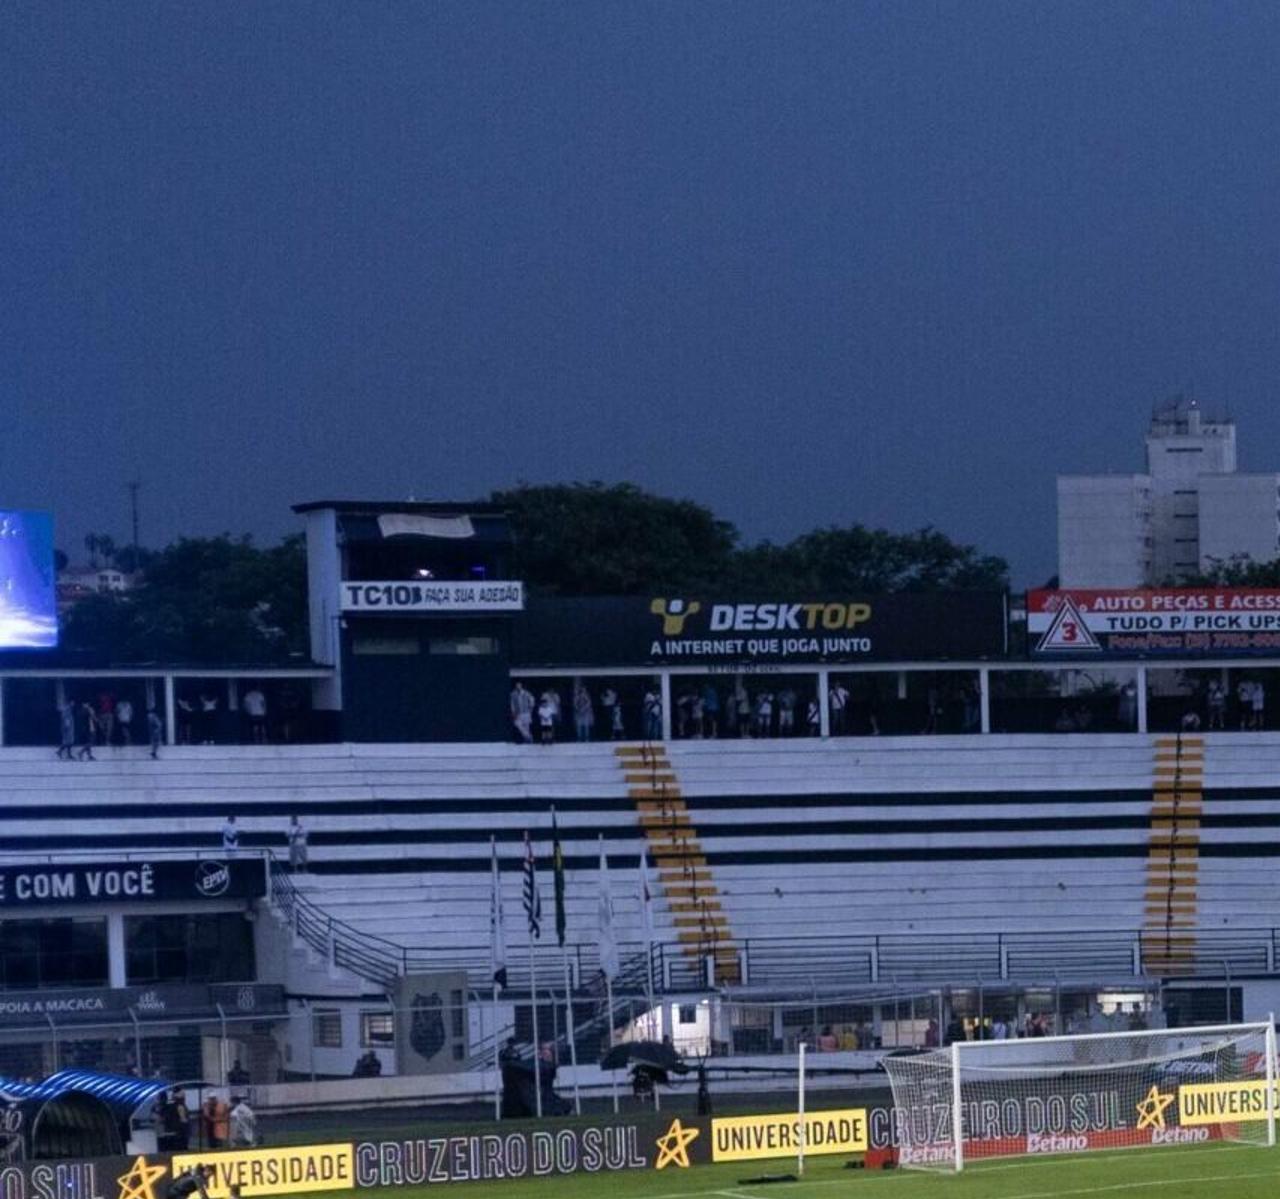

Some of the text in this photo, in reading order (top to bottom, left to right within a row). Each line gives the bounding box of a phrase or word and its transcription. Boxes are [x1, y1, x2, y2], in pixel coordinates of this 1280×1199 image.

[454, 587, 475, 603] SUA
[1093, 596, 1145, 611] AUTO
[1151, 595, 1209, 613] PEÇAS
[1215, 595, 1225, 609] E
[709, 603, 872, 632] DESKTOP
[1107, 617, 1163, 630] TUDO
[1194, 615, 1242, 629] PICK
[1061, 622, 1078, 642] 3
[650, 637, 871, 656] A INTERNET QUE JOGA JUNTO
[15, 872, 76, 900] COM
[84, 863, 155, 897] VOCÊ
[716, 1118, 863, 1152] UNIVERSIDADE
[1026, 1094, 1064, 1135] DO
[1070, 1090, 1128, 1133] SUL
[1027, 1132, 1089, 1153] Betano
[1151, 1126, 1209, 1144] Betano
[356, 1133, 528, 1188] CRUZEIRO
[533, 1128, 577, 1175] DO
[582, 1125, 646, 1171] SUL
